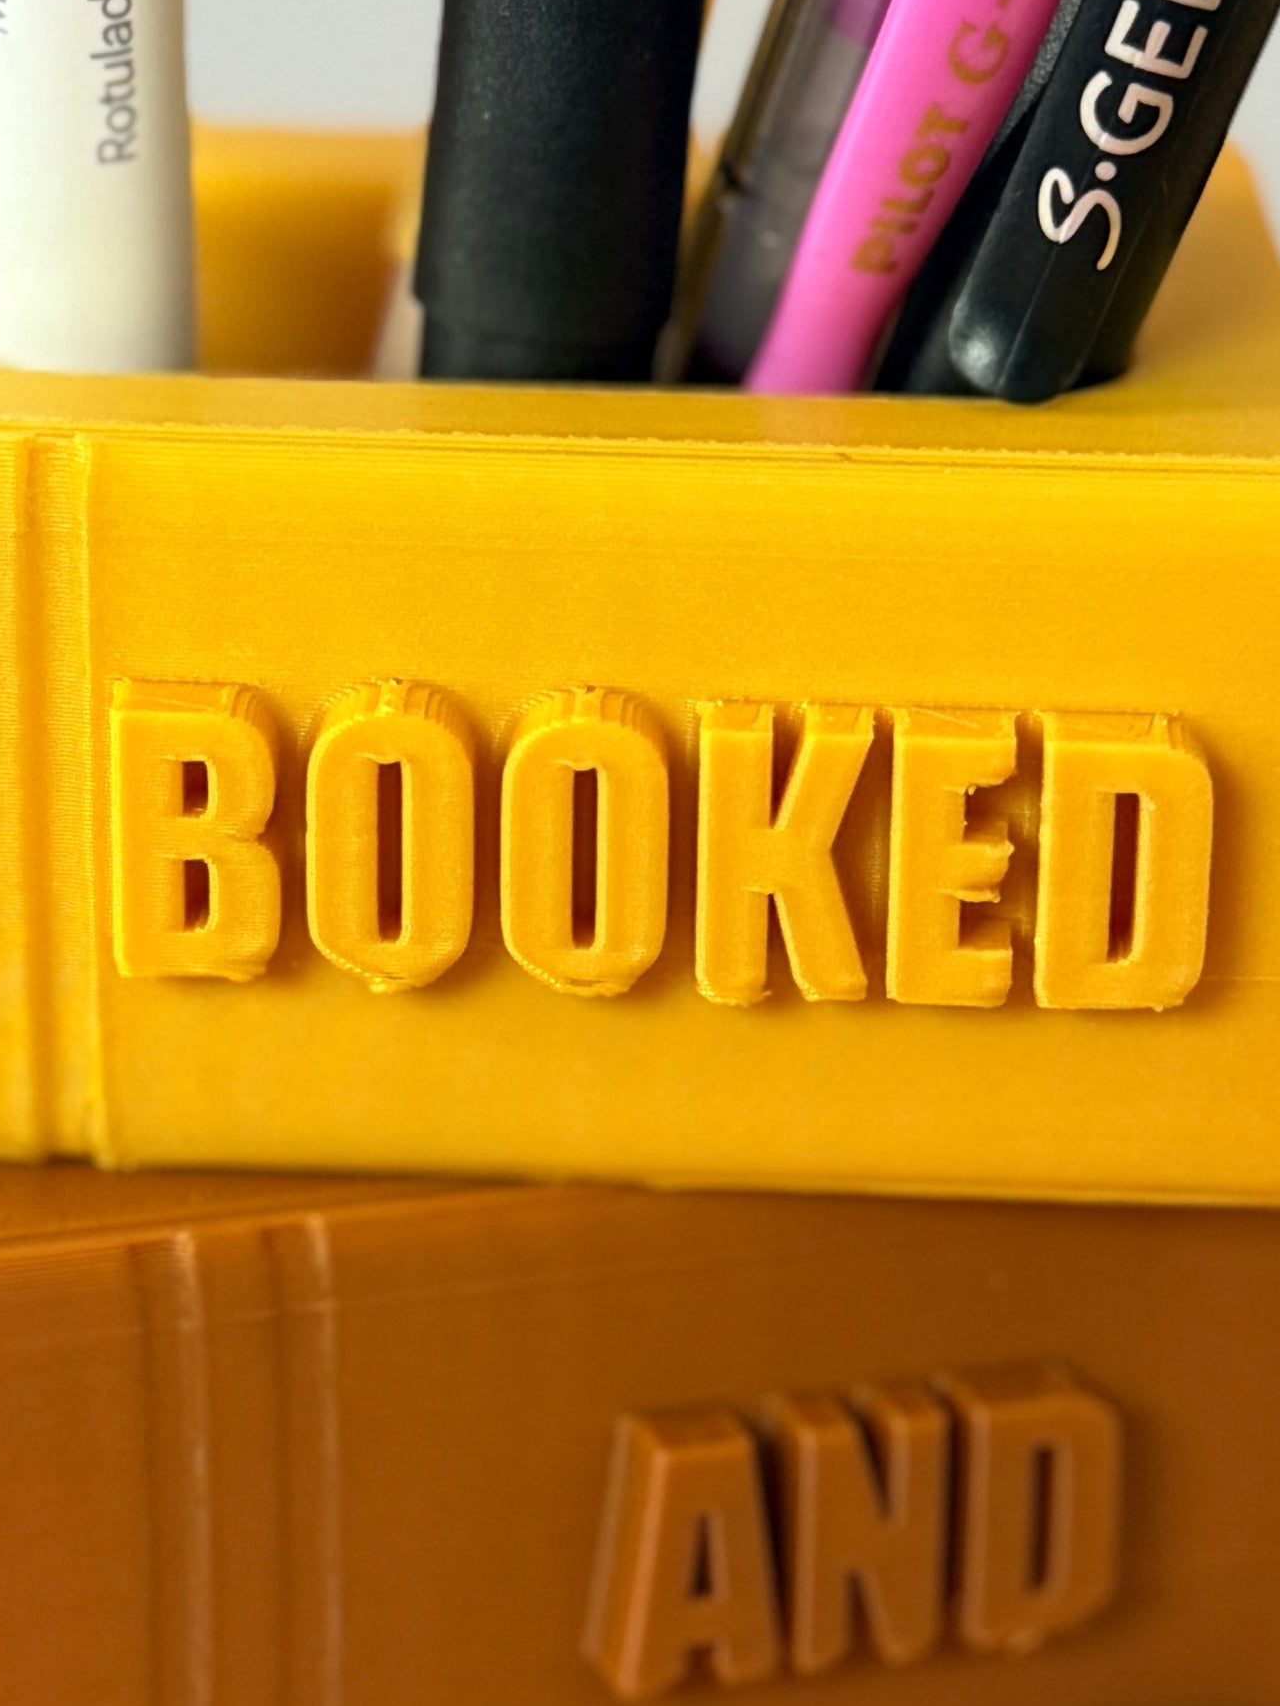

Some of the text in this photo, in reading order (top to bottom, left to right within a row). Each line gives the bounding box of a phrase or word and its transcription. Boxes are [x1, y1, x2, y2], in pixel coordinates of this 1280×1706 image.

[851, 103, 970, 275] PILOT
[110, 677, 1215, 1012] BOOKED
[577, 1360, 1122, 1700] AND
